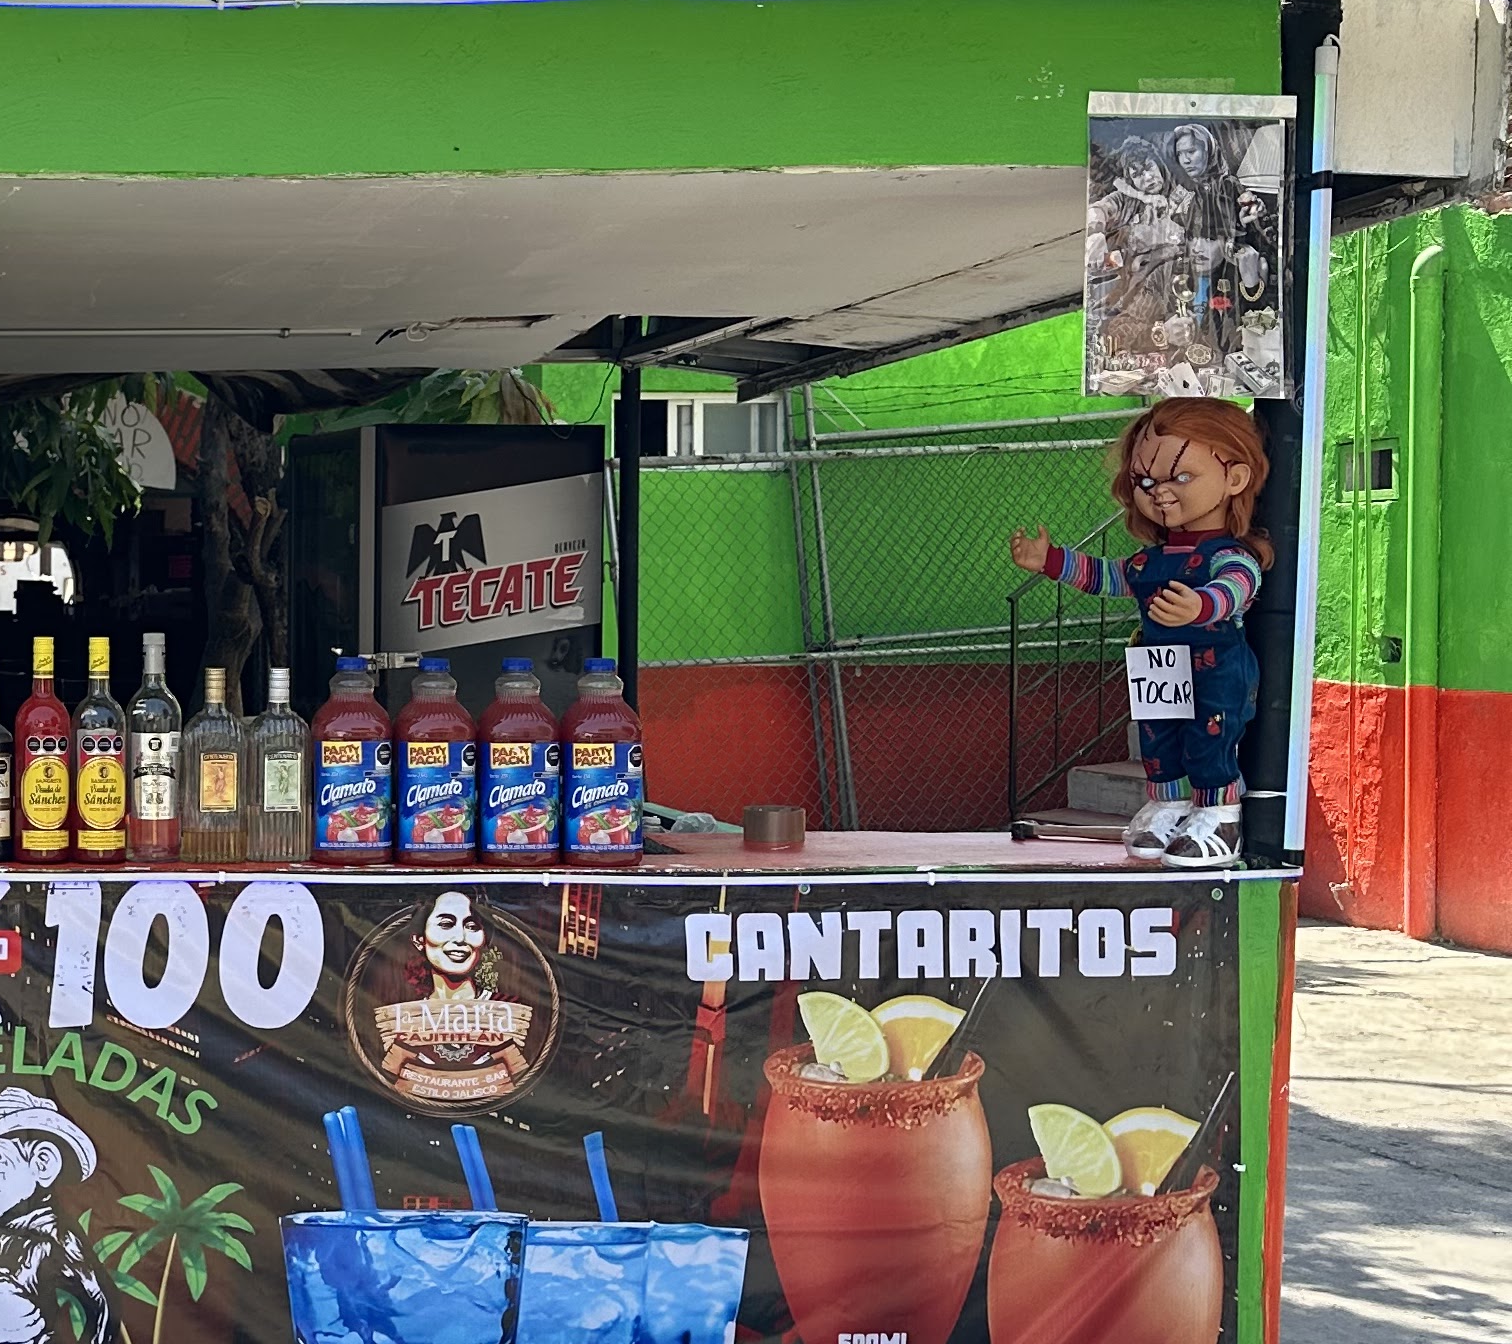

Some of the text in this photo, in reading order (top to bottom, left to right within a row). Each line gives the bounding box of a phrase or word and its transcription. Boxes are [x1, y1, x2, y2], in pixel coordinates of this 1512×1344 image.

[554, 539, 586, 554] CERVEZA
[401, 551, 590, 633] TECATE
[1146, 647, 1177, 669] NO
[1130, 677, 1193, 705] TOCAR
[323, 744, 360, 756] PARTY
[409, 745, 447, 757] PARTY
[575, 745, 613, 757] PARTY
[320, 778, 377, 806] Clamato
[406, 779, 463, 807] Clamato
[488, 779, 546, 808] Clamato
[571, 780, 629, 808] Clamato
[44, 881, 326, 1031] 100
[684, 908, 1178, 982] CANTARITOS
[402, 1069, 480, 1088] RESTAURANTE
[411, 1084, 498, 1099] ESTILO JALISCO
